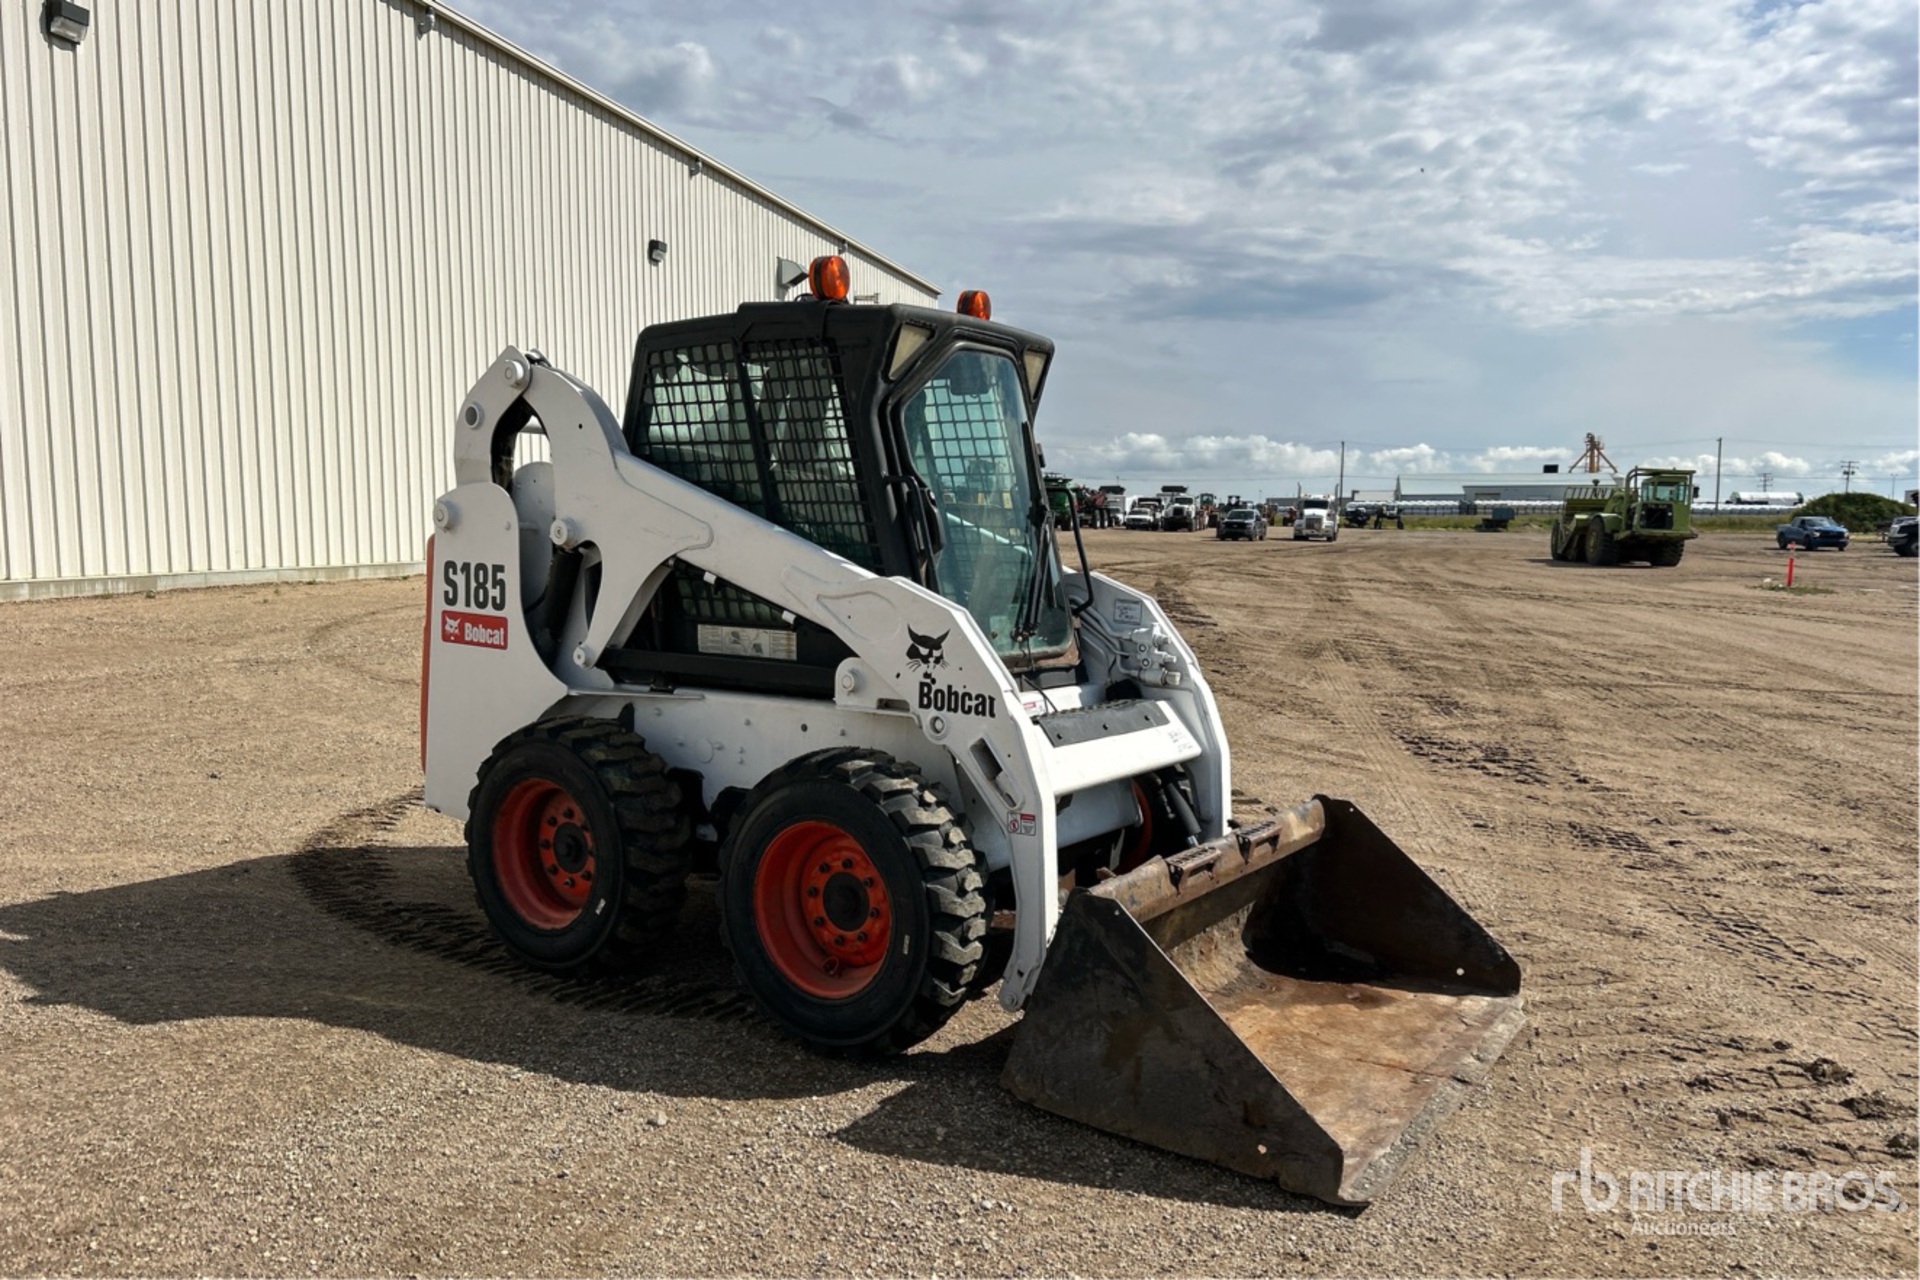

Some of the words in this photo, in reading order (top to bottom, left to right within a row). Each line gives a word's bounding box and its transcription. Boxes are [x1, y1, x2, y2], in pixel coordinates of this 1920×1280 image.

[443, 560, 506, 612] S185
[464, 621, 505, 646] Bobcat
[918, 681, 996, 718] Bobcat
